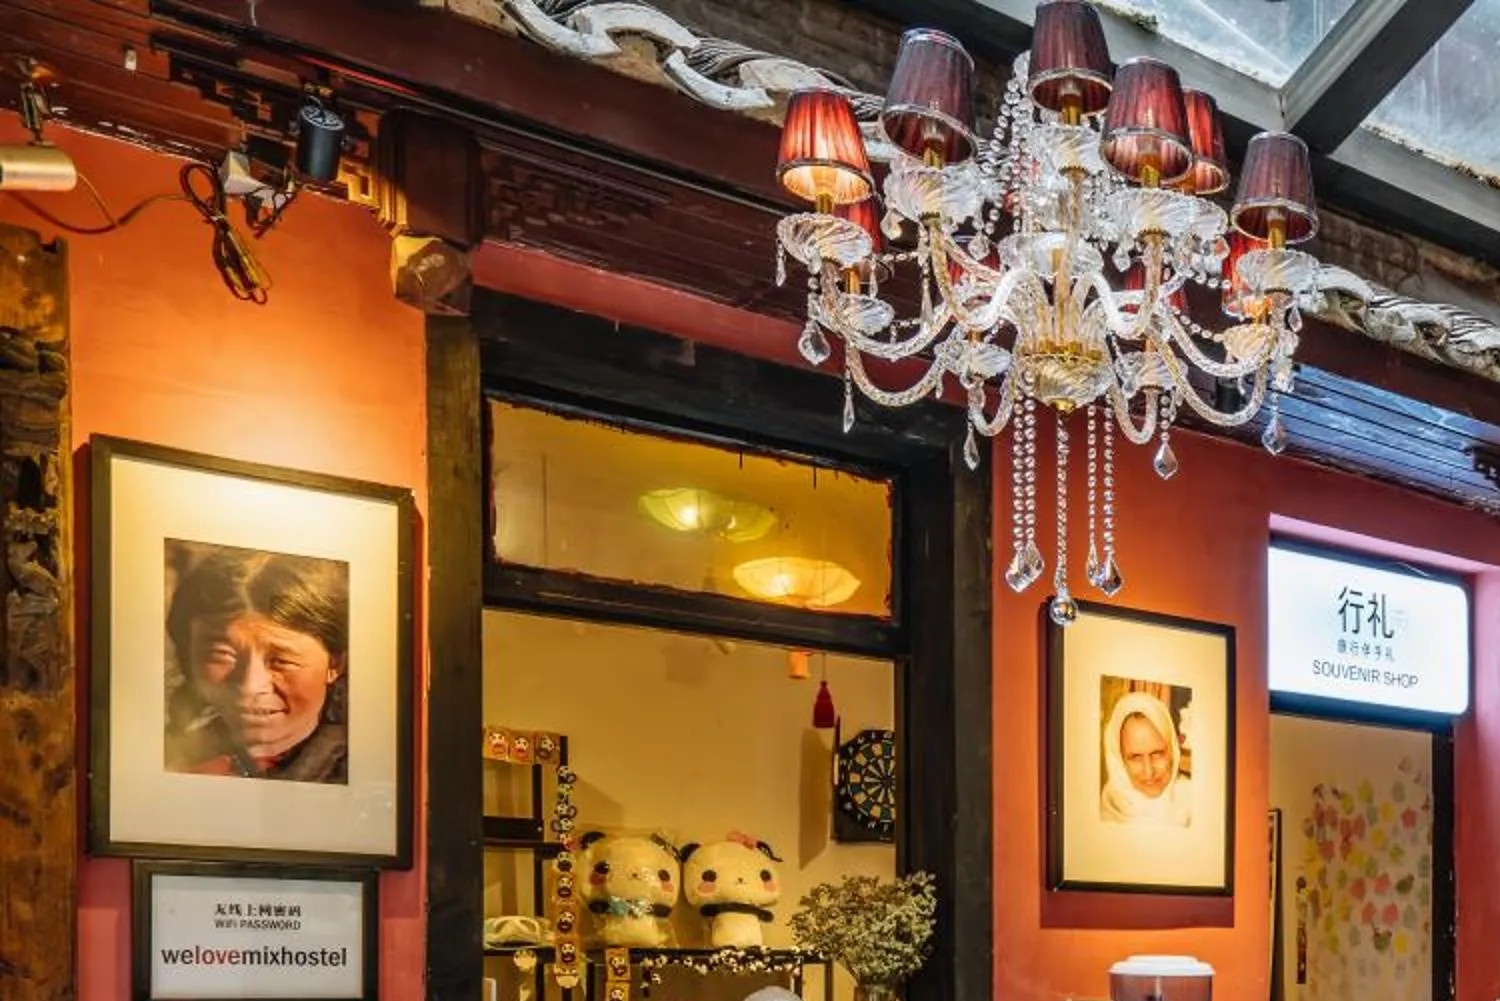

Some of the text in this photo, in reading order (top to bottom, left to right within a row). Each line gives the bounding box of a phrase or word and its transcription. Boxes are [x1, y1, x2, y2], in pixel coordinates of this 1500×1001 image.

[1337, 585, 1395, 639] 行礼
[1312, 659, 1419, 689] SOUVENIR SHOP
[240, 919, 301, 931] PASSWORD
[161, 945, 347, 967] welovemixhostel
